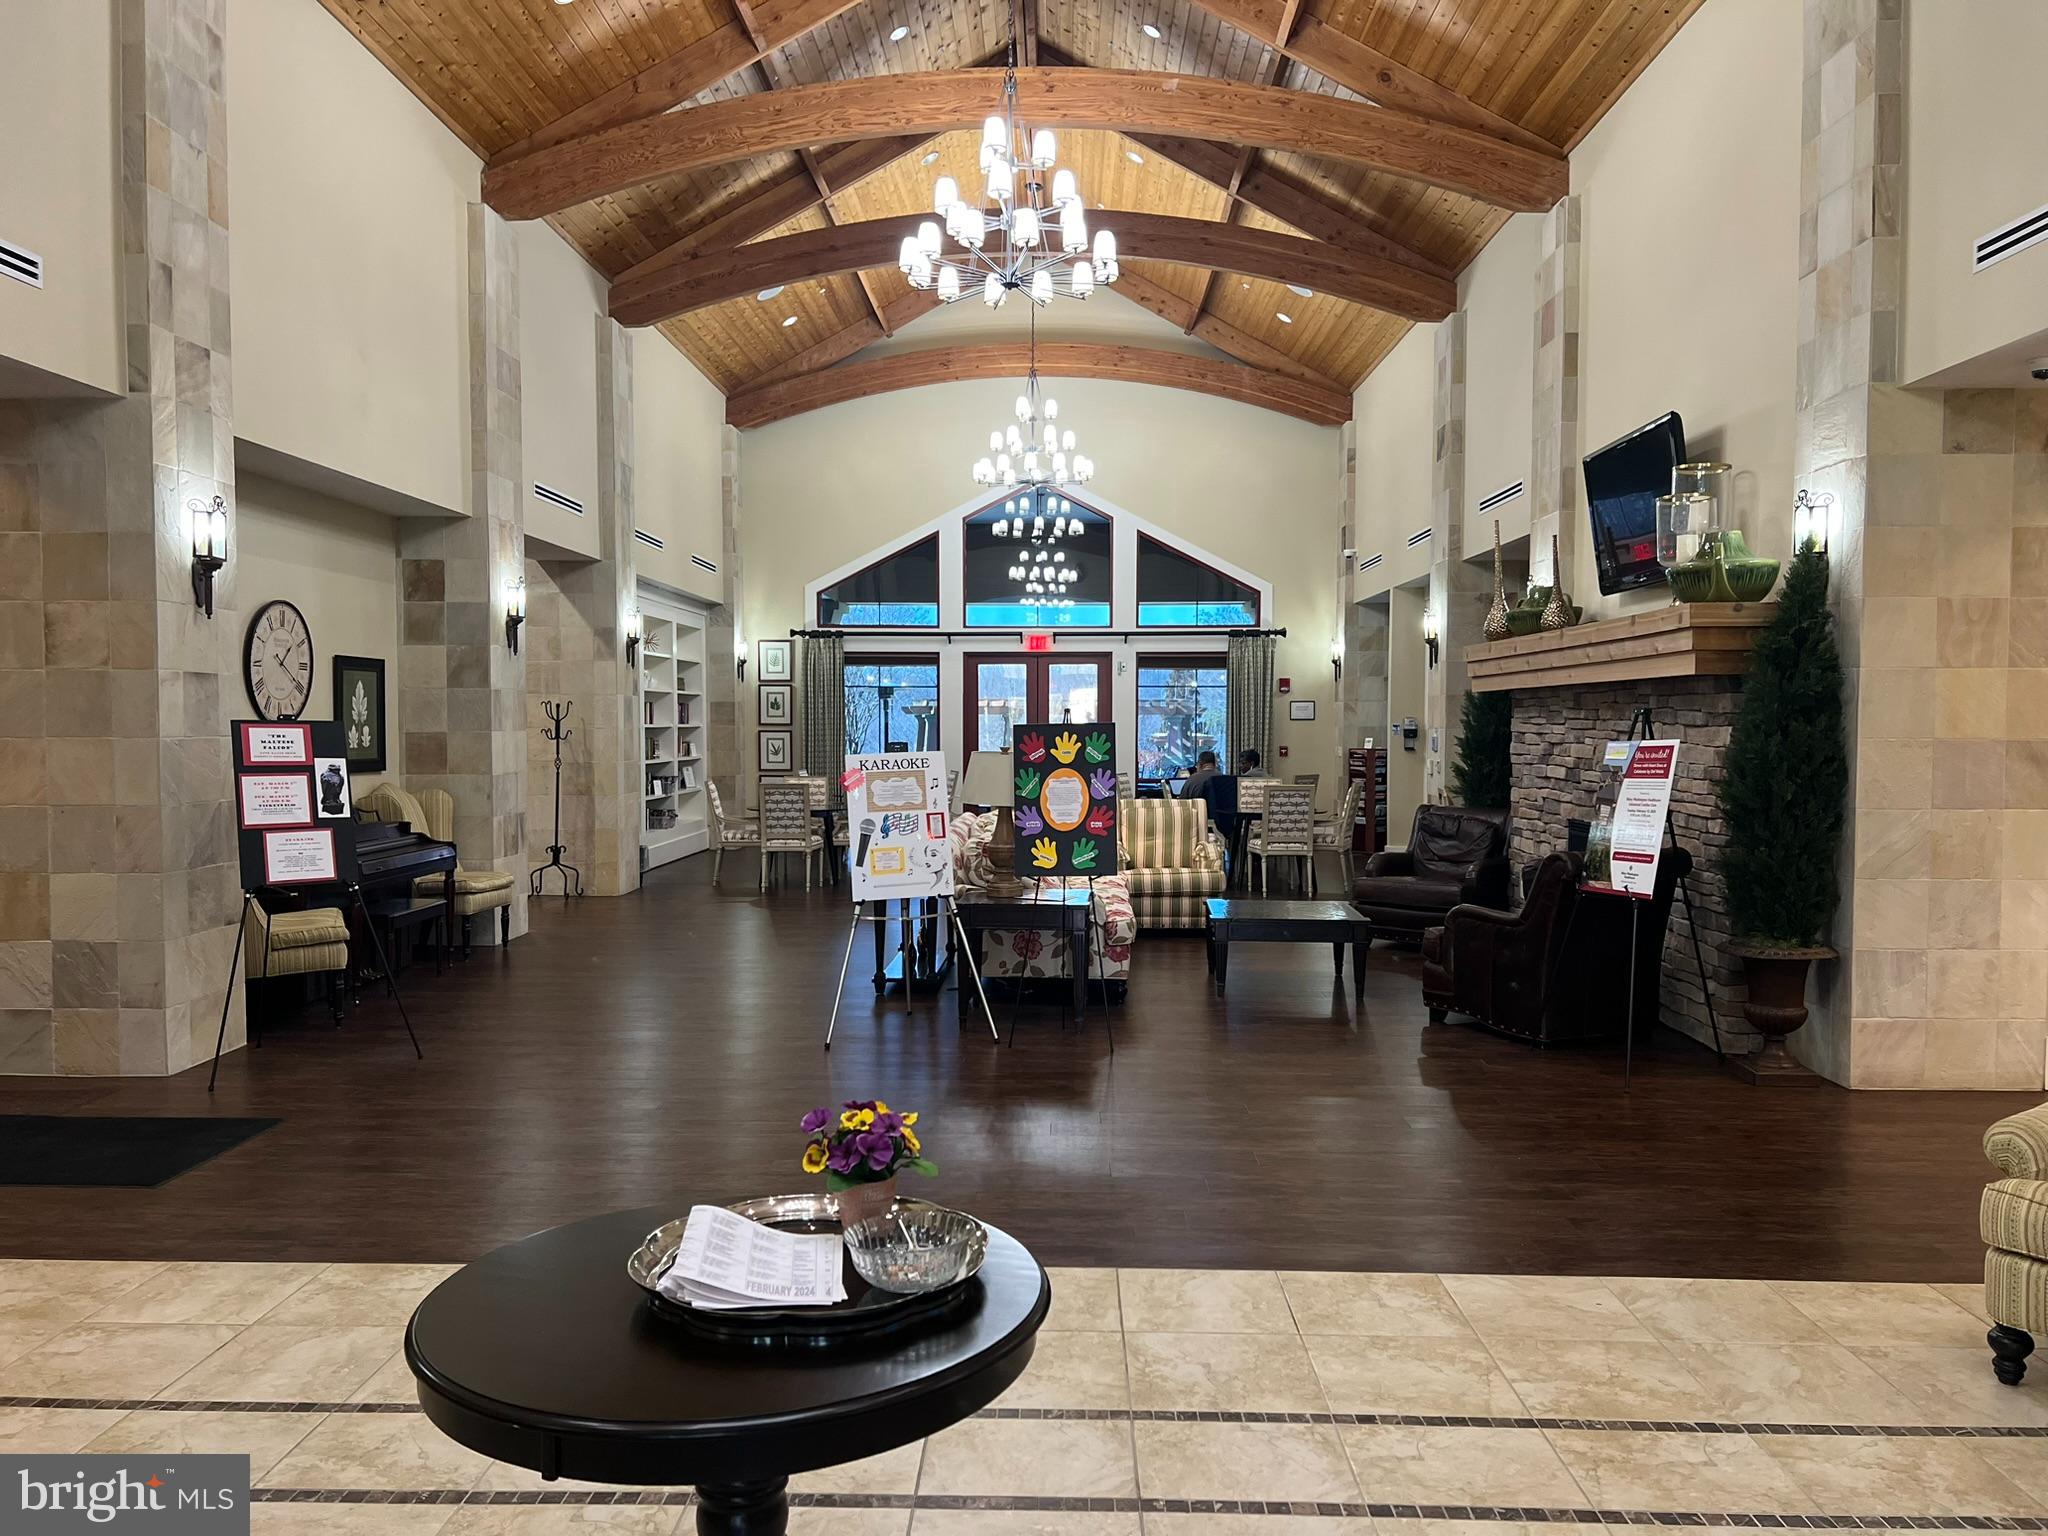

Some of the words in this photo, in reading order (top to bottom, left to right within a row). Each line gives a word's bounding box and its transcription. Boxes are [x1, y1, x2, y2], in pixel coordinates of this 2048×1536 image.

[859, 757, 930, 771] KARAOKE
[746, 1281, 792, 1297] FEBRUARY
[794, 1286, 817, 1297] 2024
